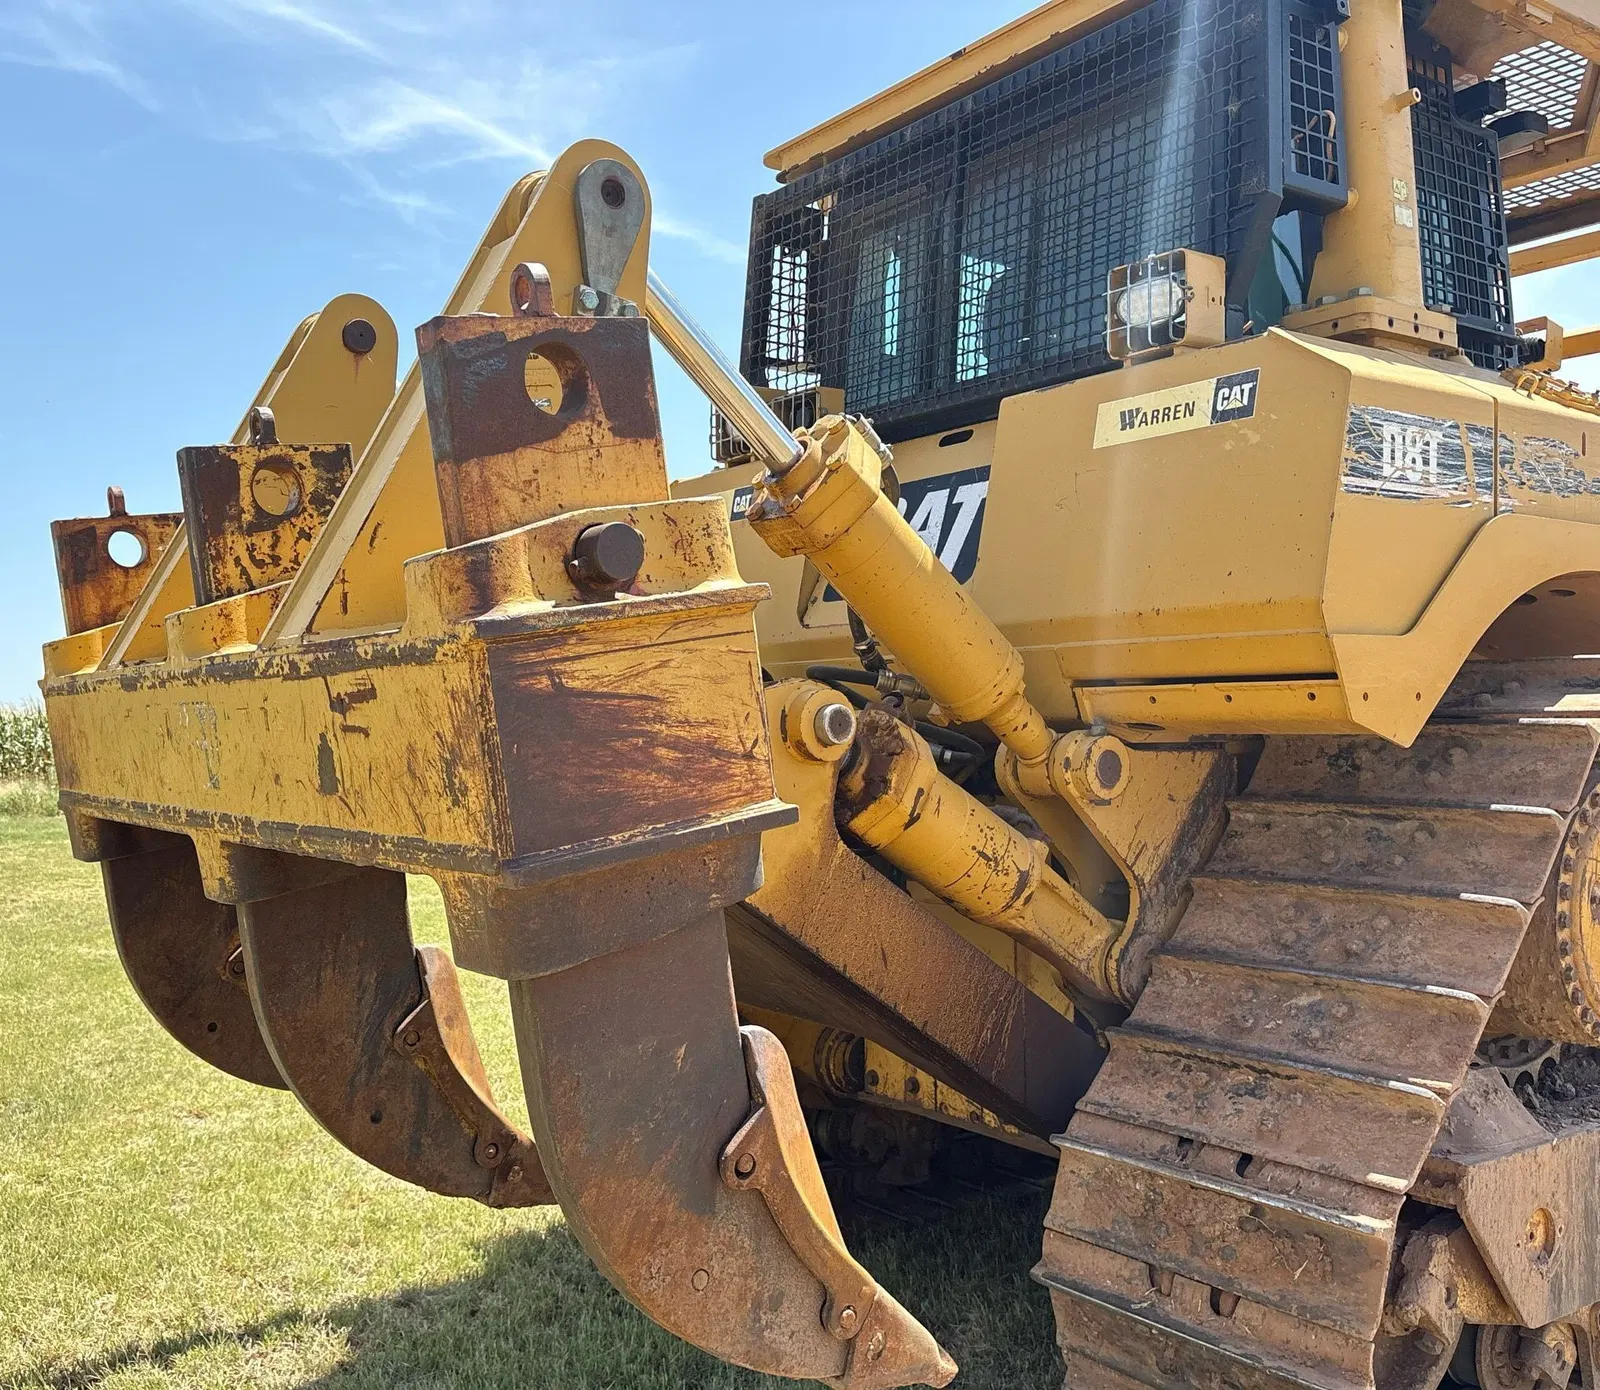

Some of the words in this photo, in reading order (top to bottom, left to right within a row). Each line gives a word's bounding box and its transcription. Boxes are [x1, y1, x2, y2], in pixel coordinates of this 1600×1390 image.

[1120, 400, 1196, 431] WARREN
[1216, 381, 1254, 412] CAT
[733, 494, 752, 513] CAT
[896, 480, 990, 573] AT
